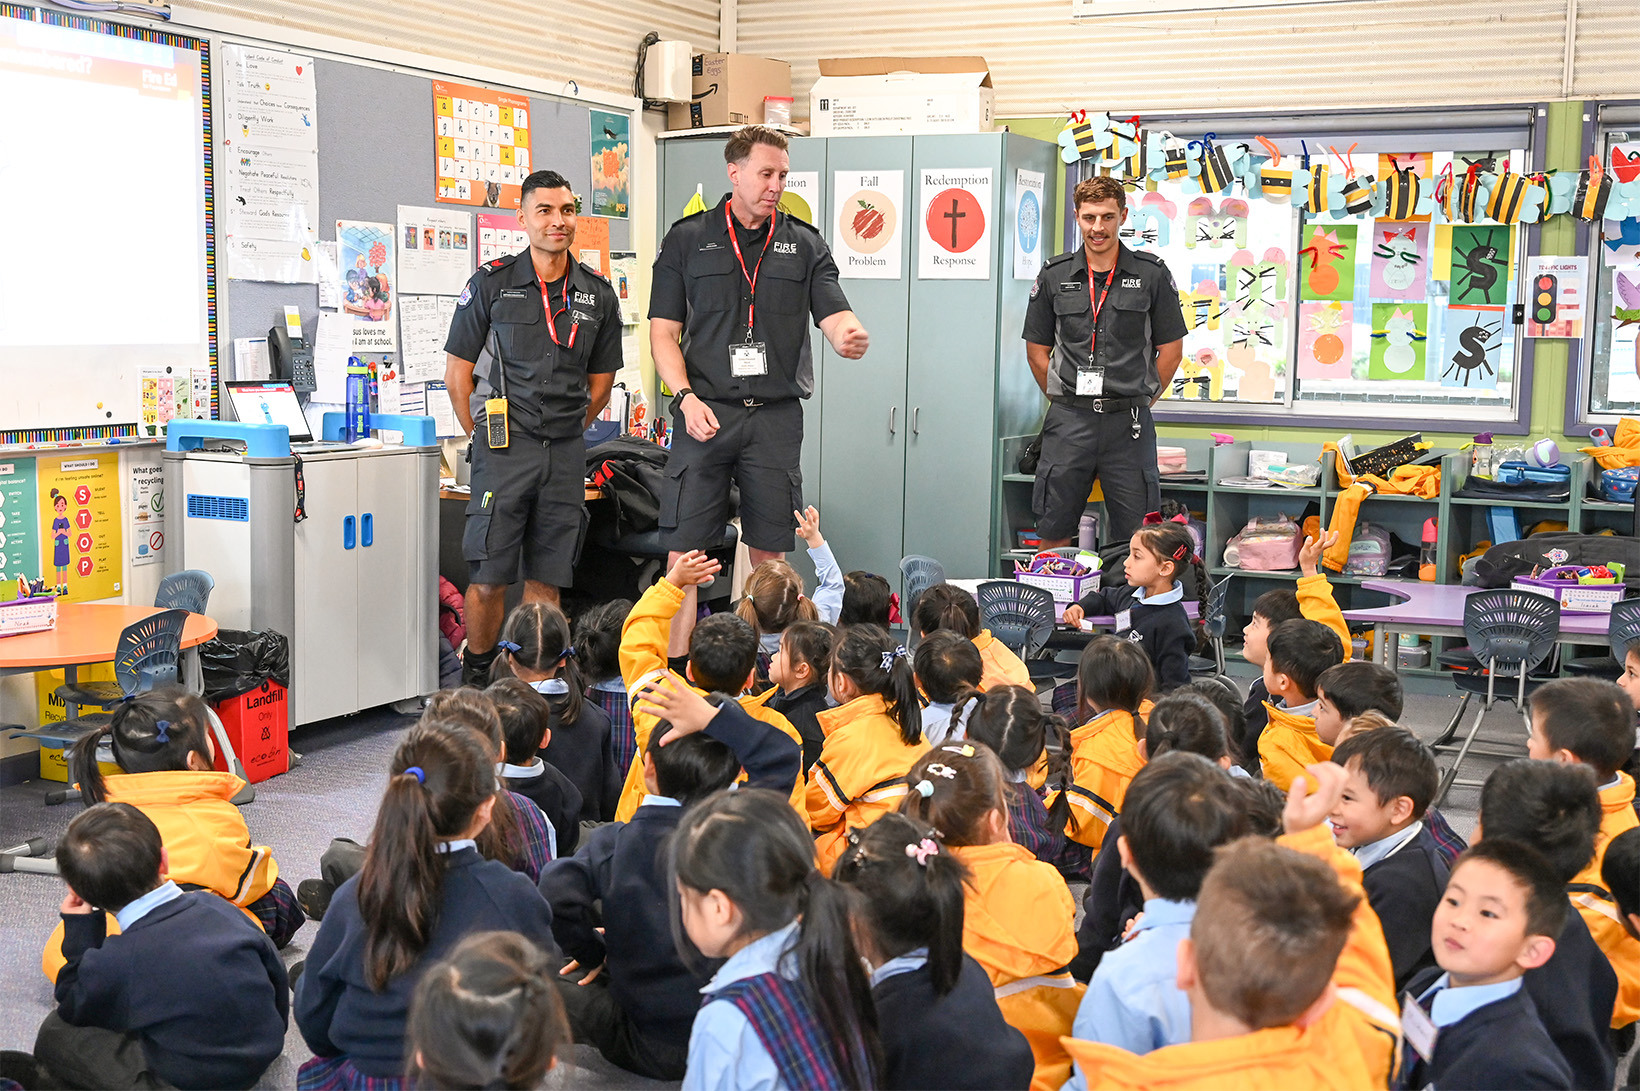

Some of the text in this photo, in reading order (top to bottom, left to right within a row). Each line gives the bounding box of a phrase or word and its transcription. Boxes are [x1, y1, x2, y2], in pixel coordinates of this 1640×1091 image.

[704, 57, 725, 66] Easter
[706, 67, 722, 76] Eggs
[142, 69, 178, 87] Fire Ed
[260, 99, 275, 107] Choices
[284, 102, 310, 112] Consequences
[508, 98, 527, 107] Phonograms
[238, 113, 259, 124] Diligently
[443, 123, 447, 135] g
[238, 146, 260, 157] Encourage
[239, 169, 259, 178] Negotiate
[261, 171, 279, 179] Peaceful
[860, 176, 879, 187] Fall
[925, 174, 989, 188] Redemption
[269, 188, 294, 198] Respectfully
[241, 242, 257, 251] Safety
[774, 242, 797, 250] FIRE
[849, 256, 886, 267] Problem
[933, 256, 976, 268] Response
[1022, 256, 1032, 269] Hope
[575, 292, 595, 301] FIRE
[374, 338, 393, 346] school.
[149, 466, 162, 475] goes
[138, 477, 164, 486] recycling
[80, 490, 86, 501] S
[80, 514, 87, 524] T
[80, 537, 89, 548] O
[82, 561, 88, 572] P
[247, 689, 283, 709] Landfill
[258, 712, 272, 721] Only
